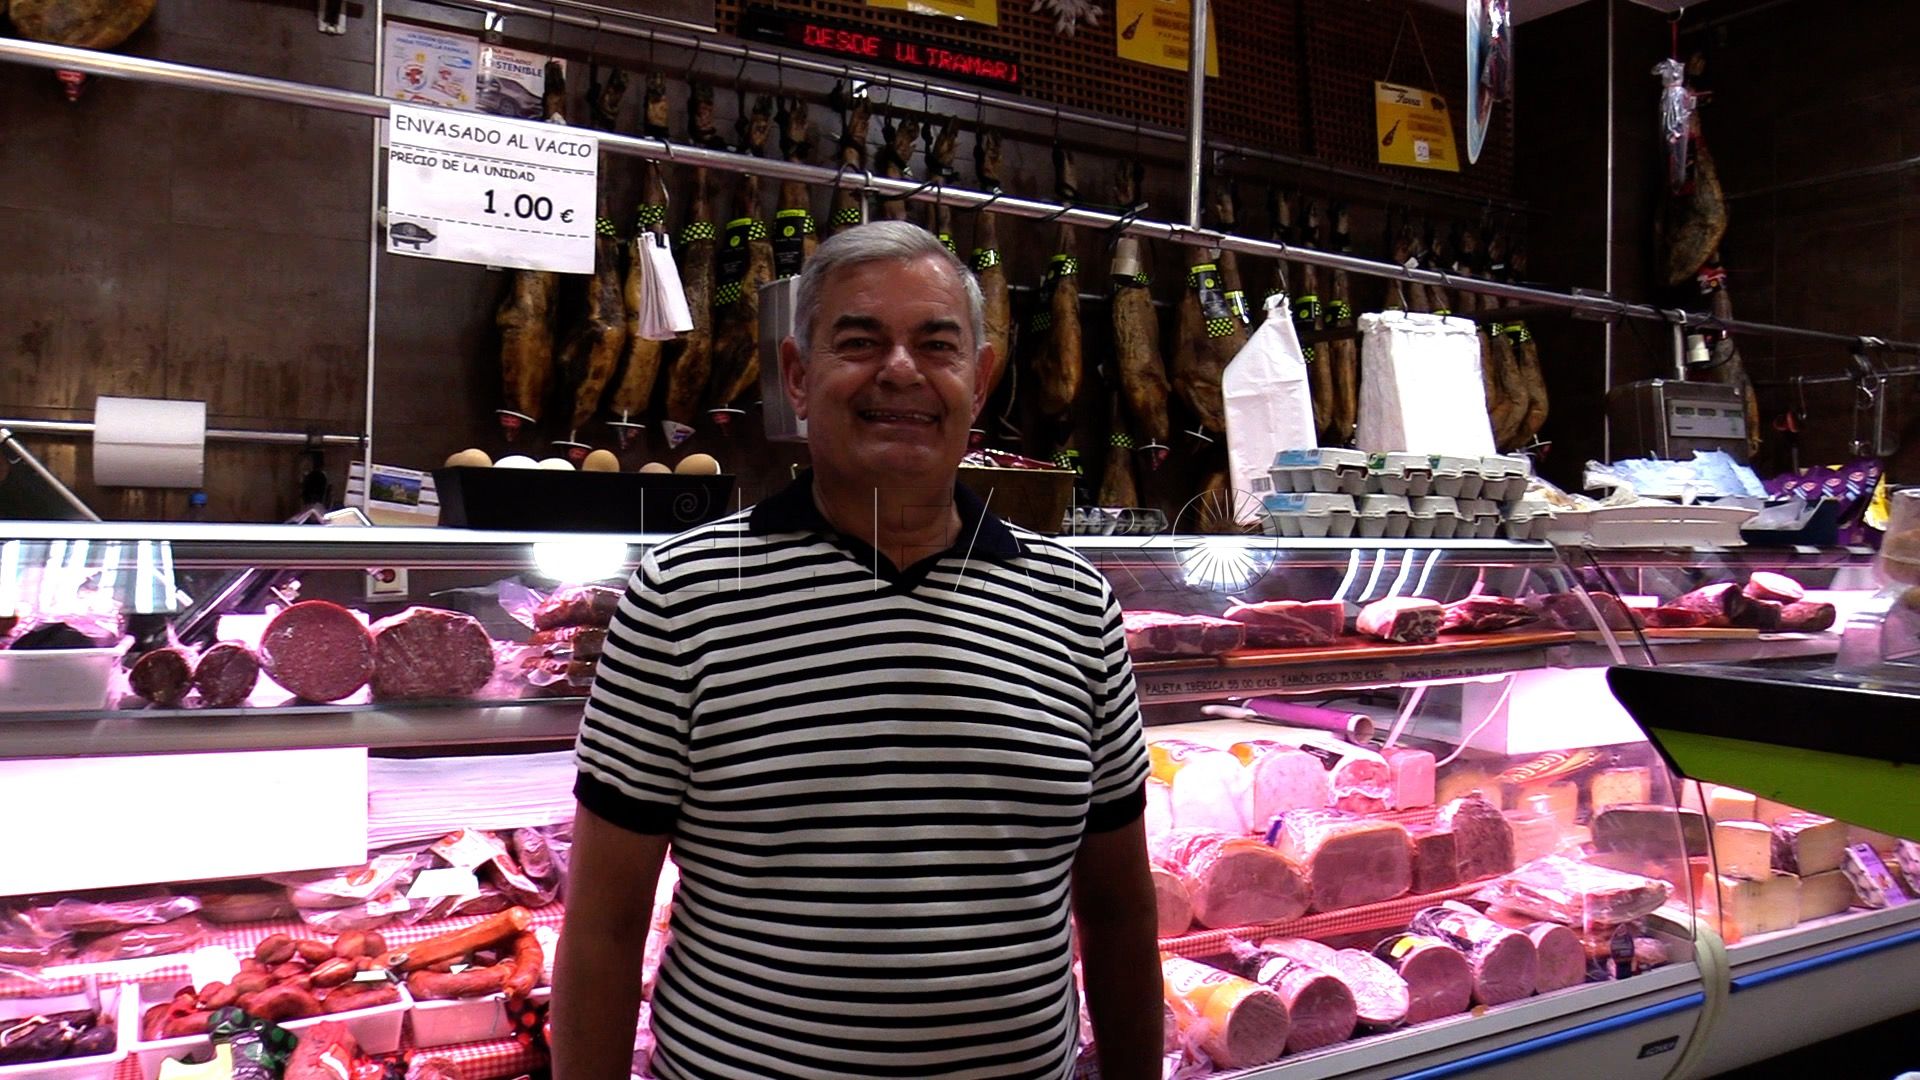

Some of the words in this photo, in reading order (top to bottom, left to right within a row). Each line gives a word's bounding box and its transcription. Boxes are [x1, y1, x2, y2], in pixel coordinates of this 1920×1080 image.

[803, 24, 881, 57] DESDE
[395, 114, 501, 145] ENVASADO
[506, 133, 530, 150] AL
[534, 136, 592, 159] VACIO
[390, 150, 438, 168] PRECIO
[442, 159, 459, 171] DE
[463, 161, 479, 174] LA
[484, 164, 536, 183] UNIDAD
[483, 188, 553, 222] 1.00
[559, 208, 575, 224] €
[1145, 682, 1182, 695] PALETA
